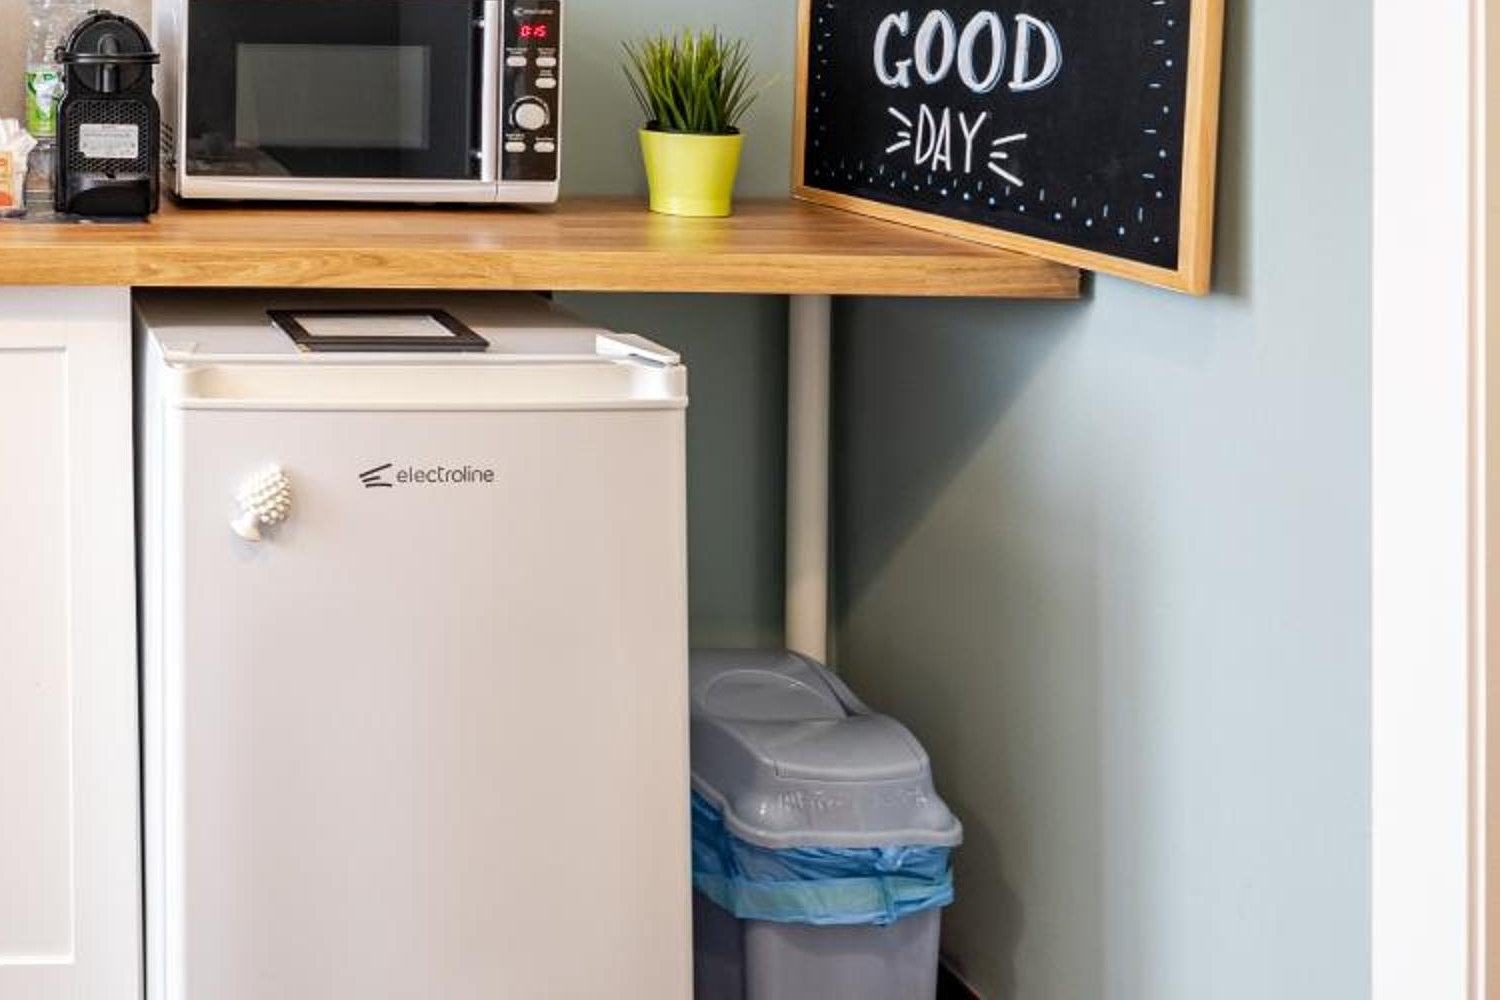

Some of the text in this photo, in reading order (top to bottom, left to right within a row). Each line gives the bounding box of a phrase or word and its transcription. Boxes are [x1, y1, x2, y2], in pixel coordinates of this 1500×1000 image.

[873, 8, 1063, 93] GOOD
[915, 104, 988, 174] DAY
[395, 465, 496, 484] electroline
